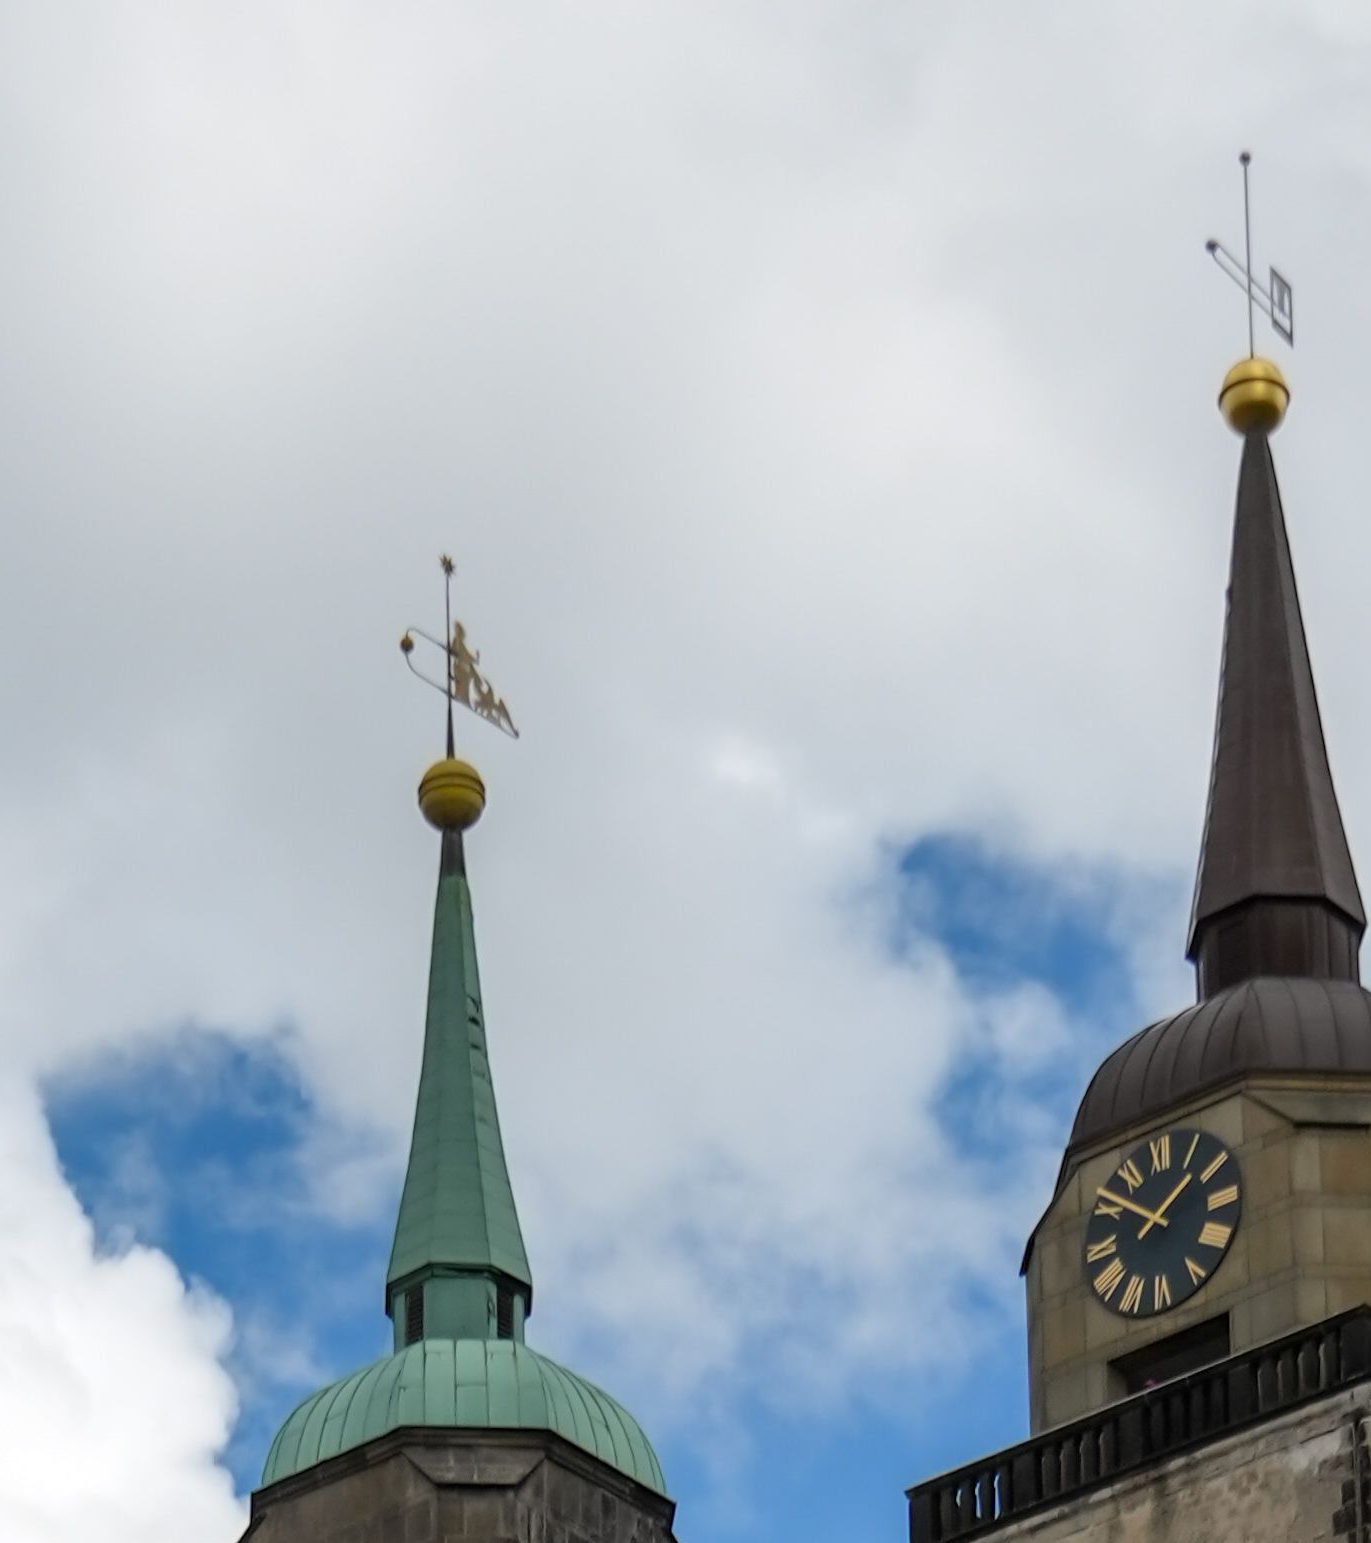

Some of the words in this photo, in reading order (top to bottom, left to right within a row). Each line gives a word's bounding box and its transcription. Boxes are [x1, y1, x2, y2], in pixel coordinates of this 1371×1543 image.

[1150, 1135, 1170, 1176] XII
[1200, 1151, 1228, 1184] II
[1117, 1159, 1144, 1195] XI
[1185, 1257, 1206, 1286] V
[1155, 1274, 1171, 1311] VI
